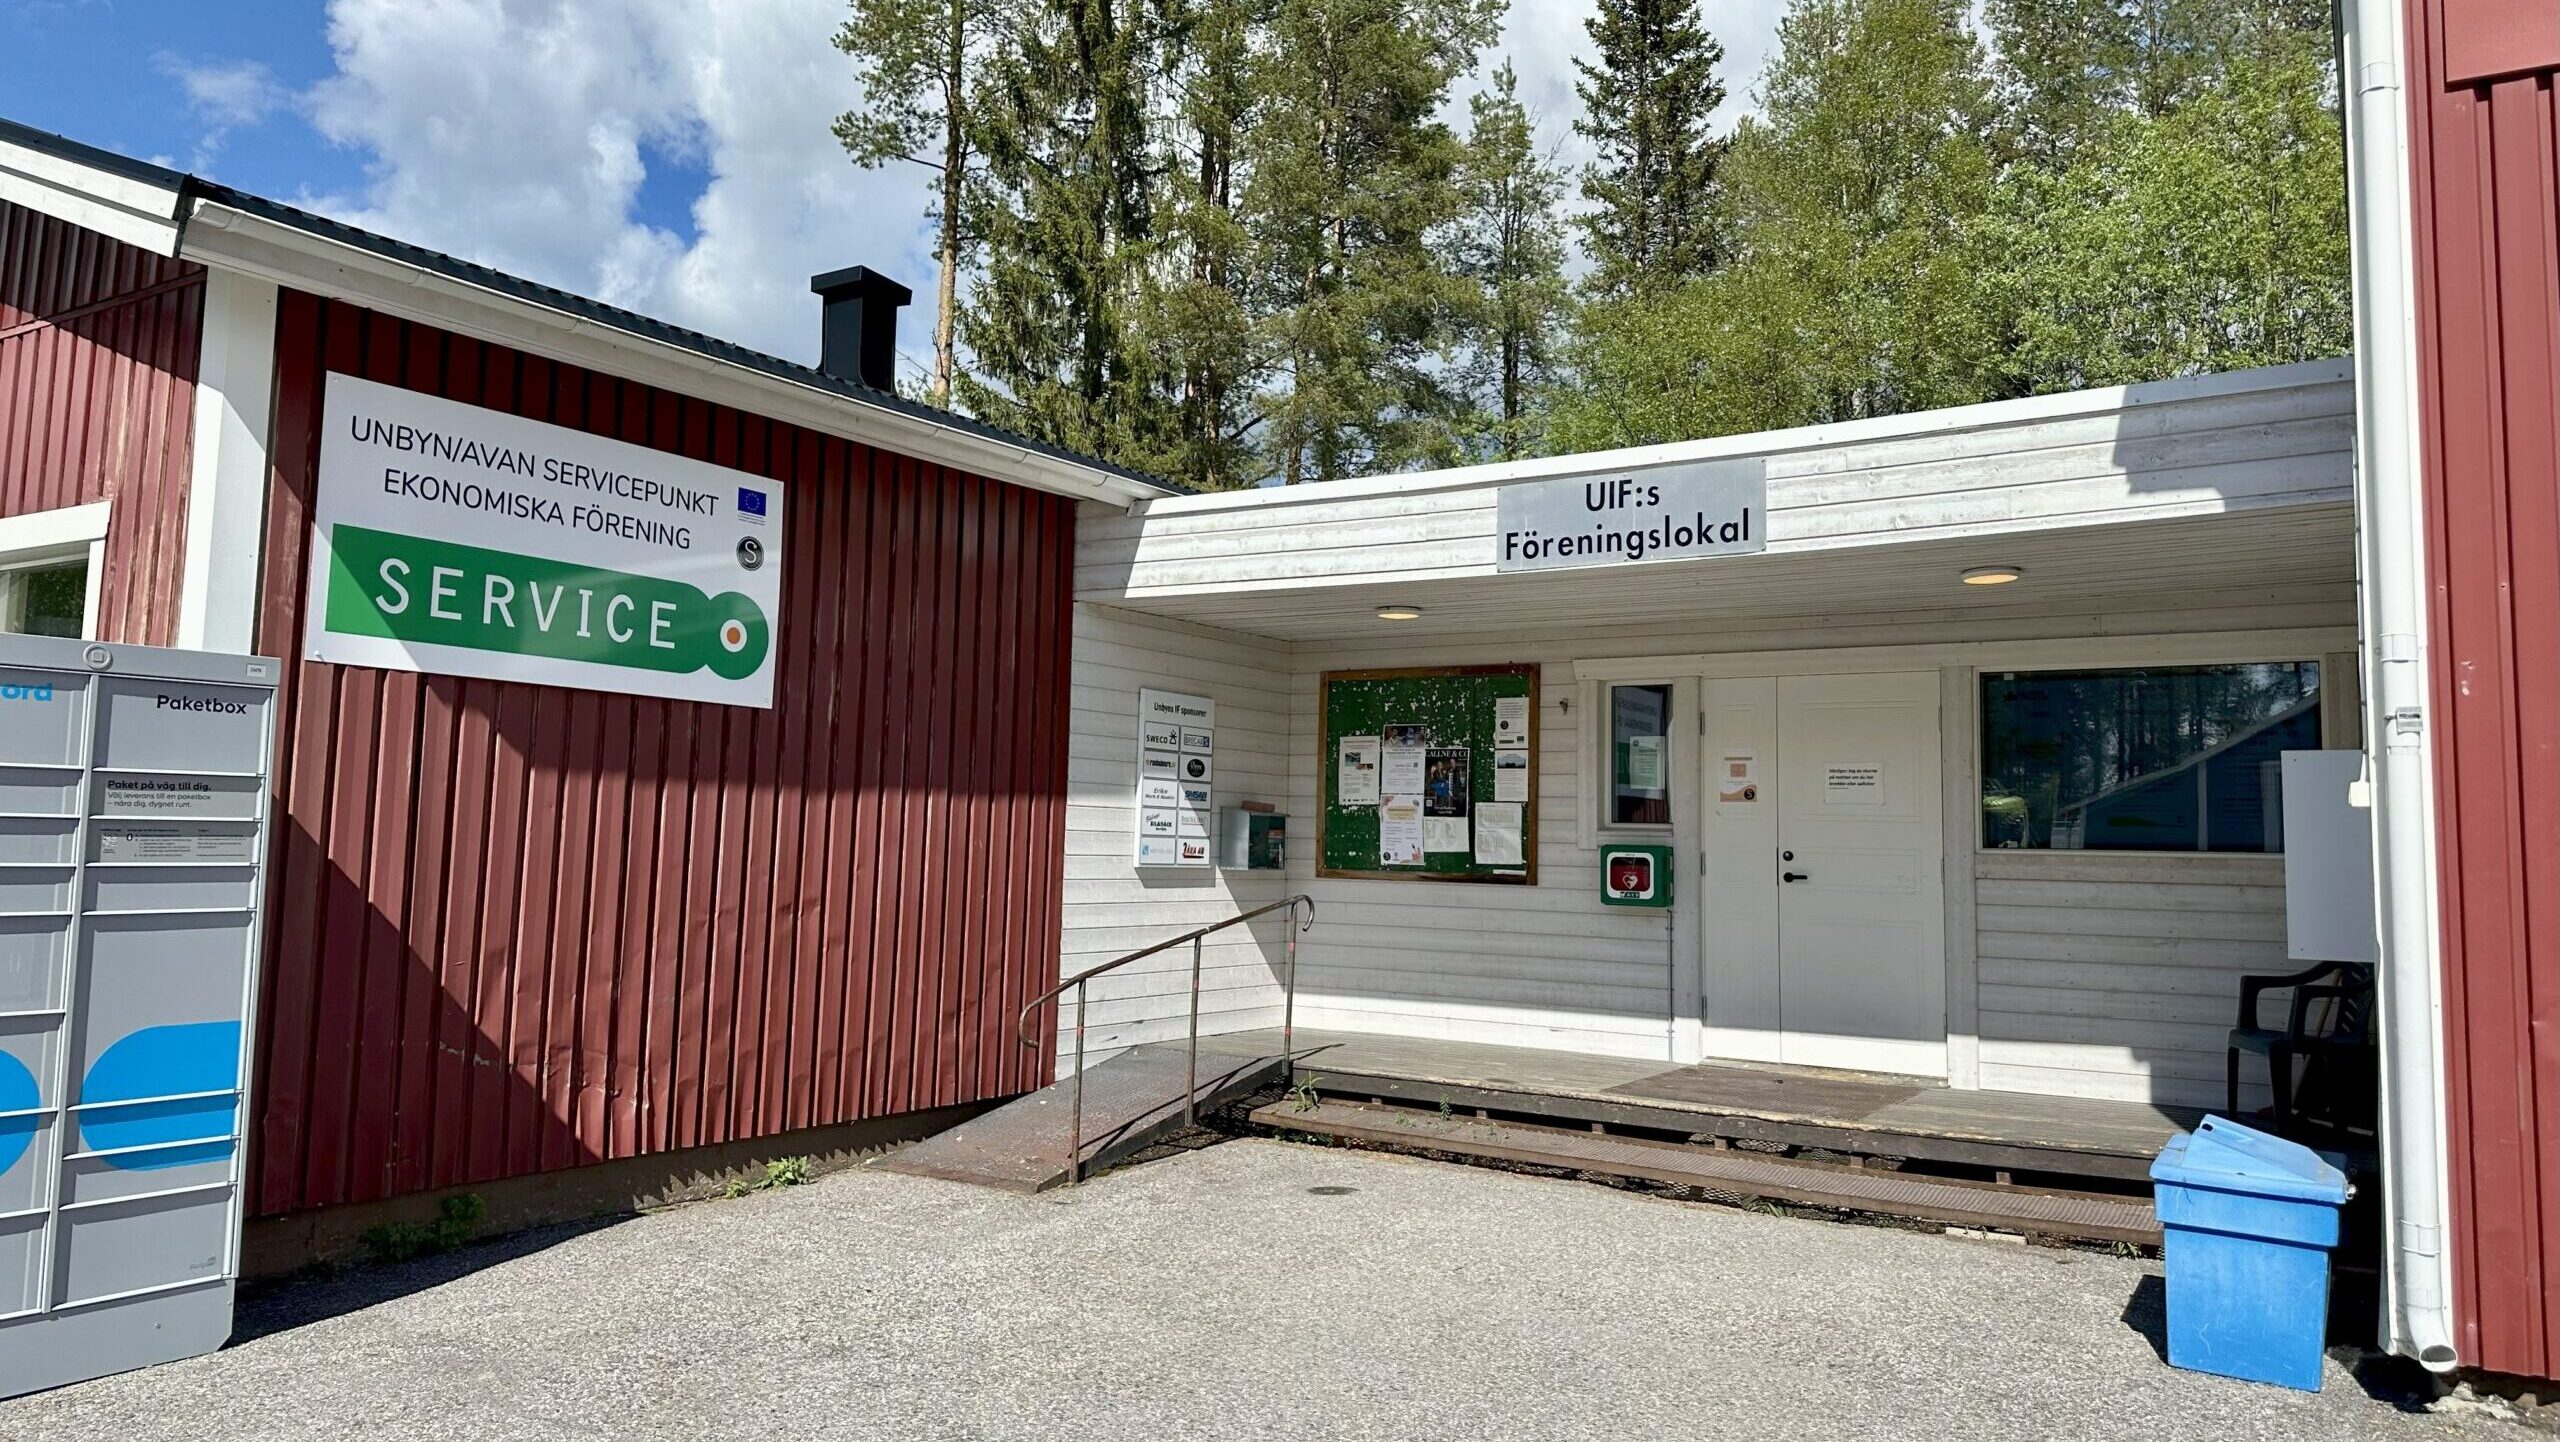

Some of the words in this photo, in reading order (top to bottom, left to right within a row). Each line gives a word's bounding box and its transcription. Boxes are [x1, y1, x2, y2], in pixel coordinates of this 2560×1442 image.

[351, 415, 535, 477] UNBYN/AVAN
[543, 459, 720, 516] SERVICEPUNKT
[1586, 479, 1660, 511] UIF:s
[384, 468, 564, 526] EKONOMISKA
[573, 503, 690, 549] FÖRENING
[1506, 508, 1749, 560] Föreningslokal
[375, 557, 677, 650] SERVICE
[156, 694, 247, 715] Paketbox
[1174, 704, 1180, 713] IF
[1146, 734, 1168, 744] SWECO
[107, 780, 139, 790] Paket
[141, 781, 155, 791] på
[157, 781, 176, 792] väg
[178, 781, 191, 791] till
[193, 782, 212, 793] dig.
[107, 791, 122, 800] Välj
[123, 791, 155, 800] leverans
[156, 792, 166, 800] till
